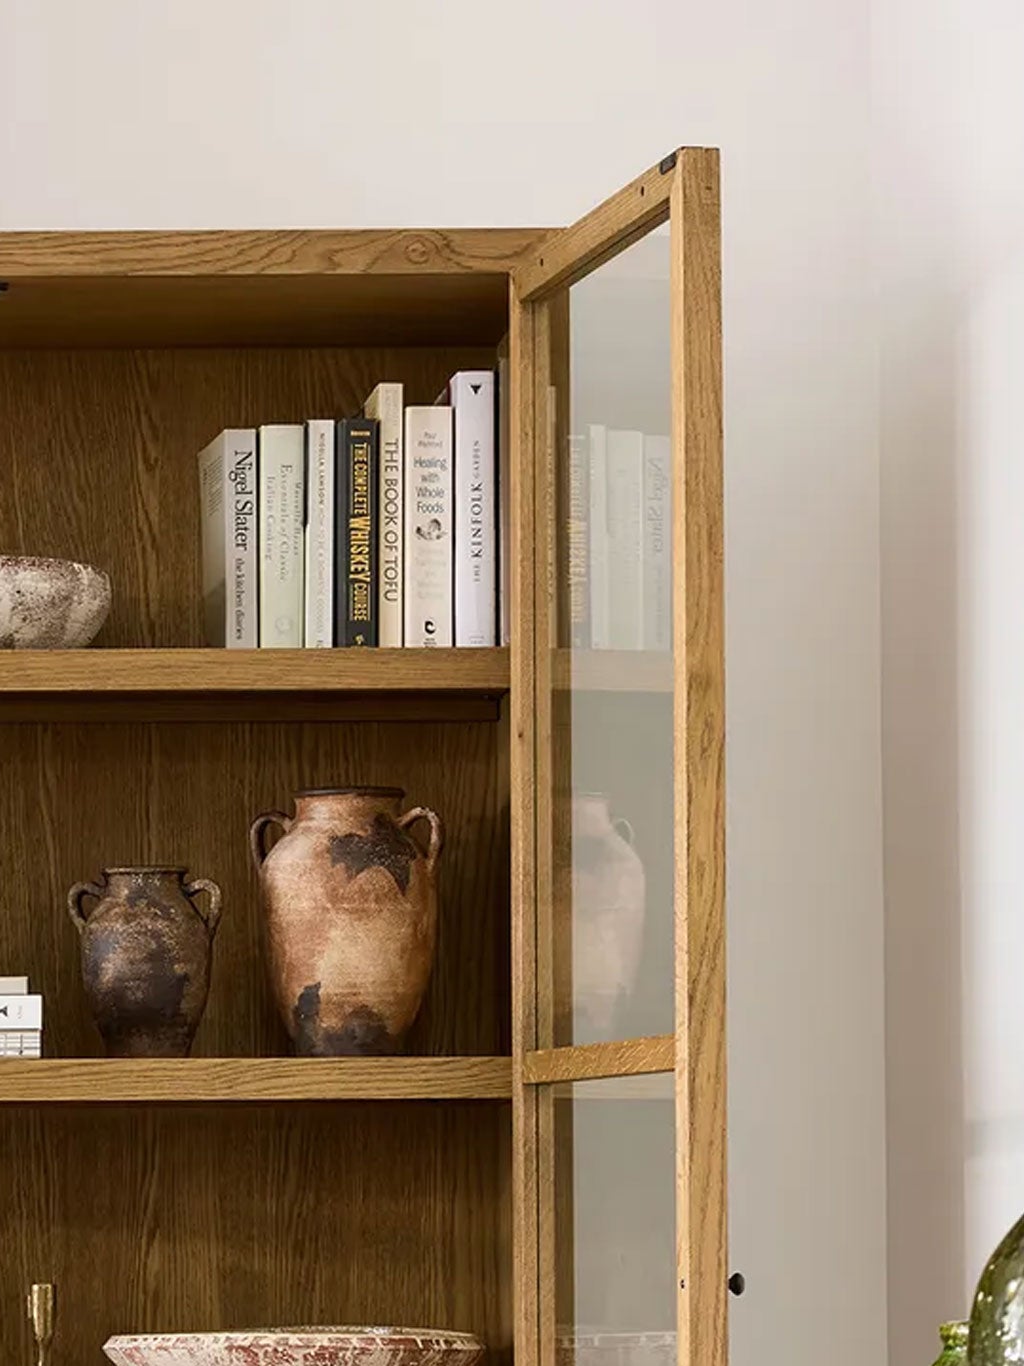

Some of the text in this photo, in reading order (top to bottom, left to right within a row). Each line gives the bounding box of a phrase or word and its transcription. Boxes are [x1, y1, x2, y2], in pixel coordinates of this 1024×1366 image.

[384, 438, 399, 472] THE
[414, 457, 447, 472] Healing
[228, 450, 253, 495] Nigel
[421, 473, 441, 484] with
[384, 479, 399, 526] BOOK
[416, 487, 446, 499] Whole
[416, 501, 445, 514] Foods
[234, 500, 254, 552] Slater
[349, 442, 371, 621] THE COMPLETE WHISKEY COURSE
[470, 482, 483, 558] KINFOLK
[384, 530, 399, 552] OF
[235, 574, 246, 607] kitchen
[384, 555, 399, 602] TOFU
